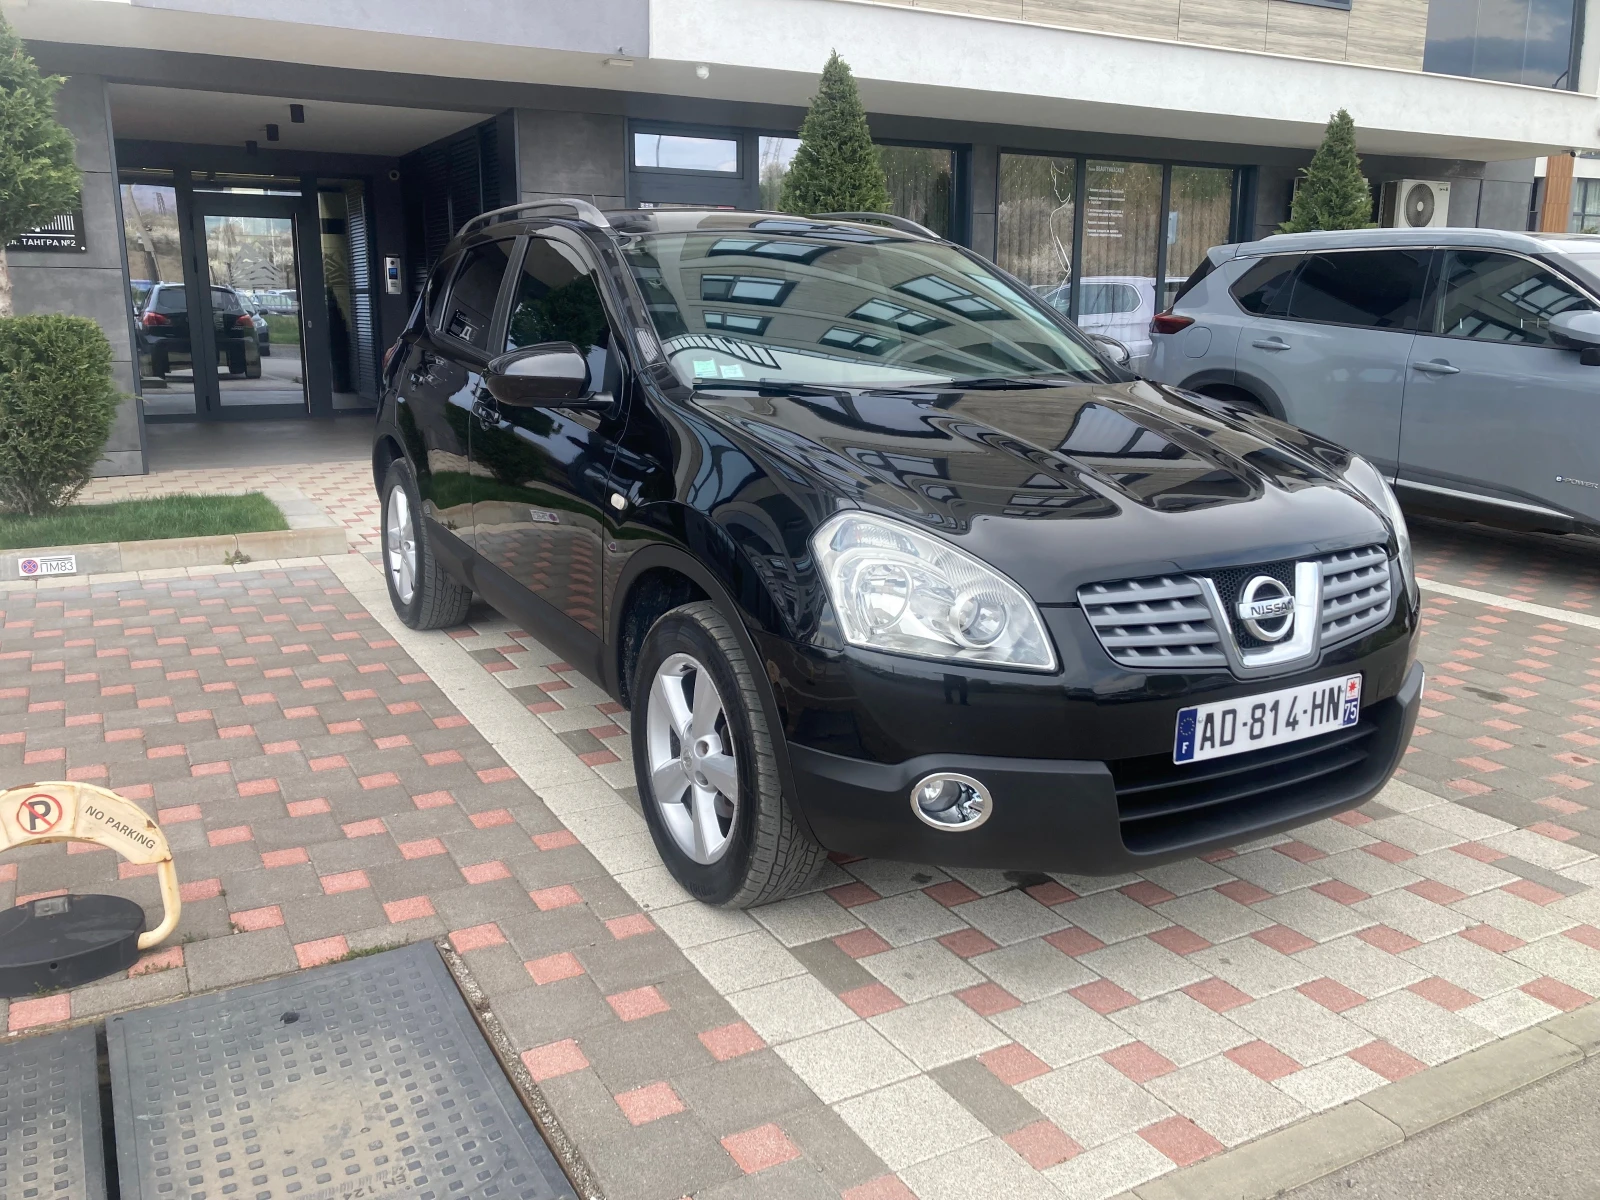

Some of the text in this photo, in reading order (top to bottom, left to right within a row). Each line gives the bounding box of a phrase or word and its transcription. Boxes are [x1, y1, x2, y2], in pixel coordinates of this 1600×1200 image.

[40, 561, 73, 572] ПМ83
[1250, 598, 1293, 615] NISSAN
[1200, 685, 1342, 751] AD-814-HN
[1344, 701, 1357, 722] 75
[1181, 742, 1189, 754] F
[28, 800, 51, 830] P
[85, 805, 156, 849] NO PARKING
[383, 1173, 406, 1189] EN
